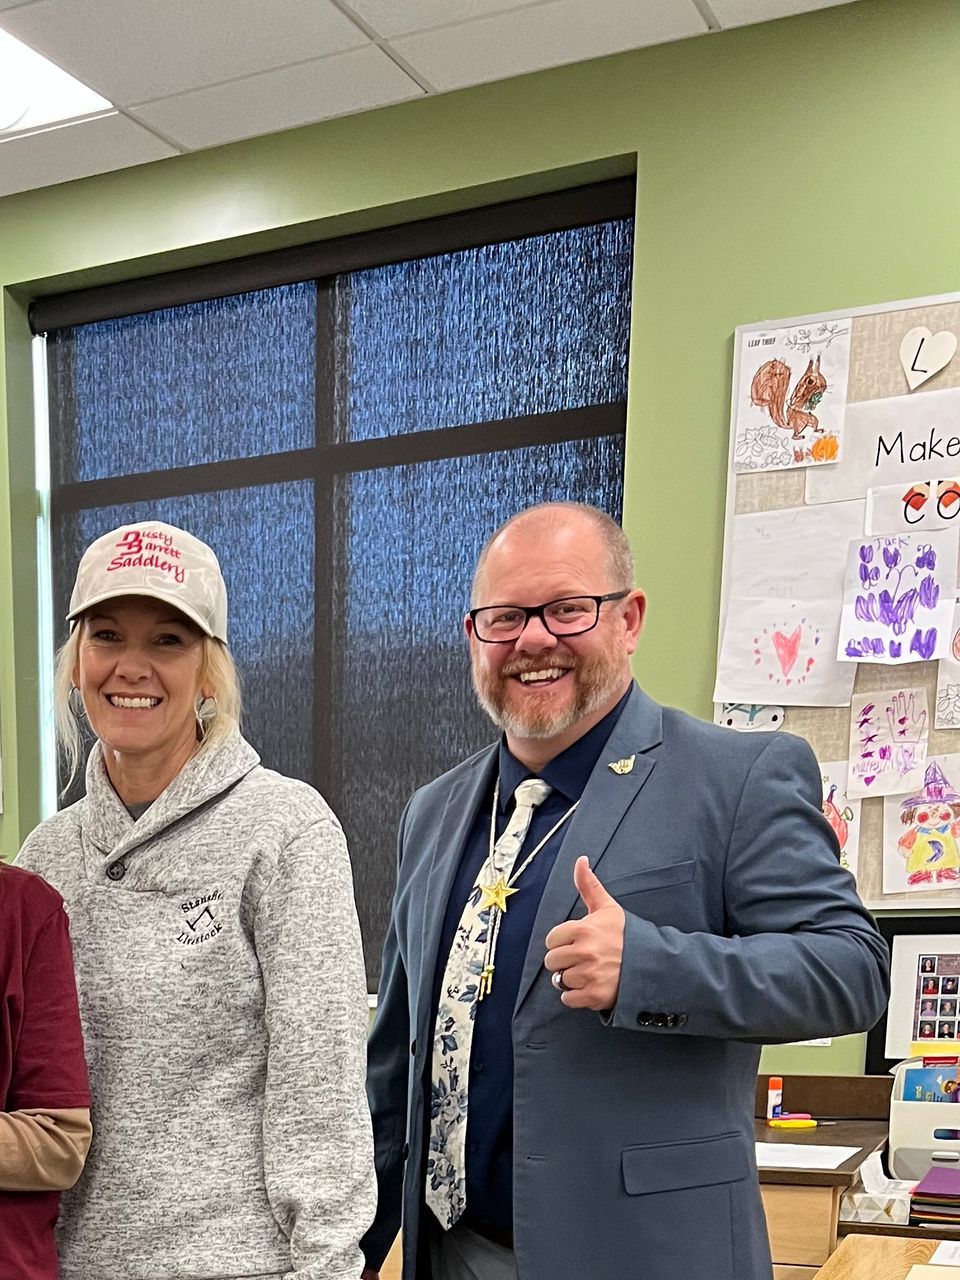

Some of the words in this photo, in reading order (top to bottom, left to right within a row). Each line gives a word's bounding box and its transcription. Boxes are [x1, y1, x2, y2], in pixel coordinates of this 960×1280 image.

[911, 337, 928, 373] L
[875, 427, 960, 467] Make
[107, 554, 185, 584] Saddlery
